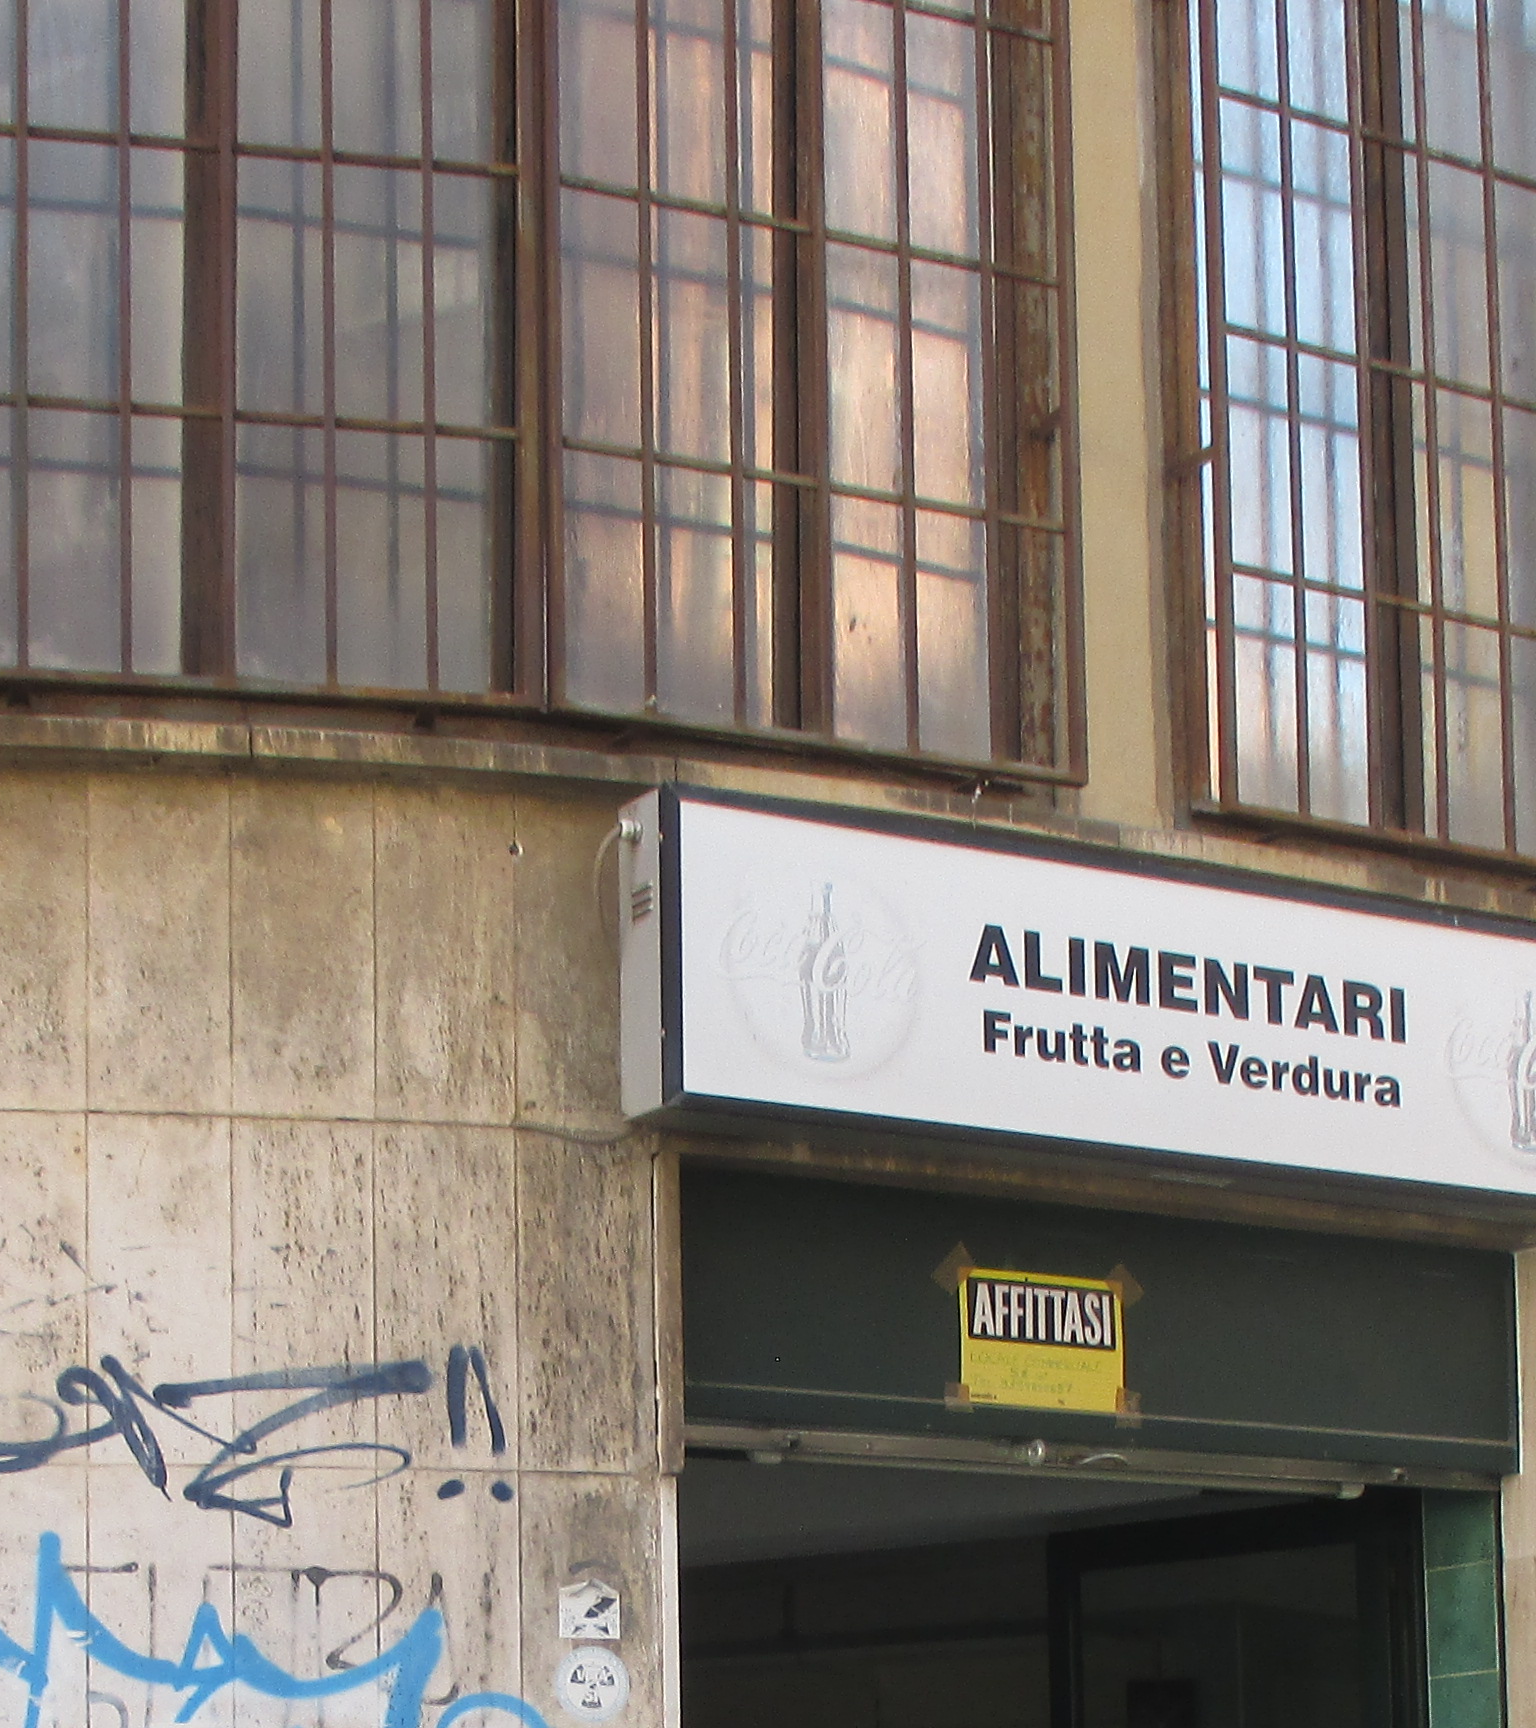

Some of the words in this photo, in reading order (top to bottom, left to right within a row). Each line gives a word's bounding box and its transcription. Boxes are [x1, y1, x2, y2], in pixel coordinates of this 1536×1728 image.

[968, 922, 1408, 1045] ALIMENTARI
[982, 1008, 1142, 1073] Frutta
[1160, 1043, 1191, 1080] e
[1206, 1040, 1403, 1109] Verdura
[972, 1281, 1113, 1347] AFFITTASI
